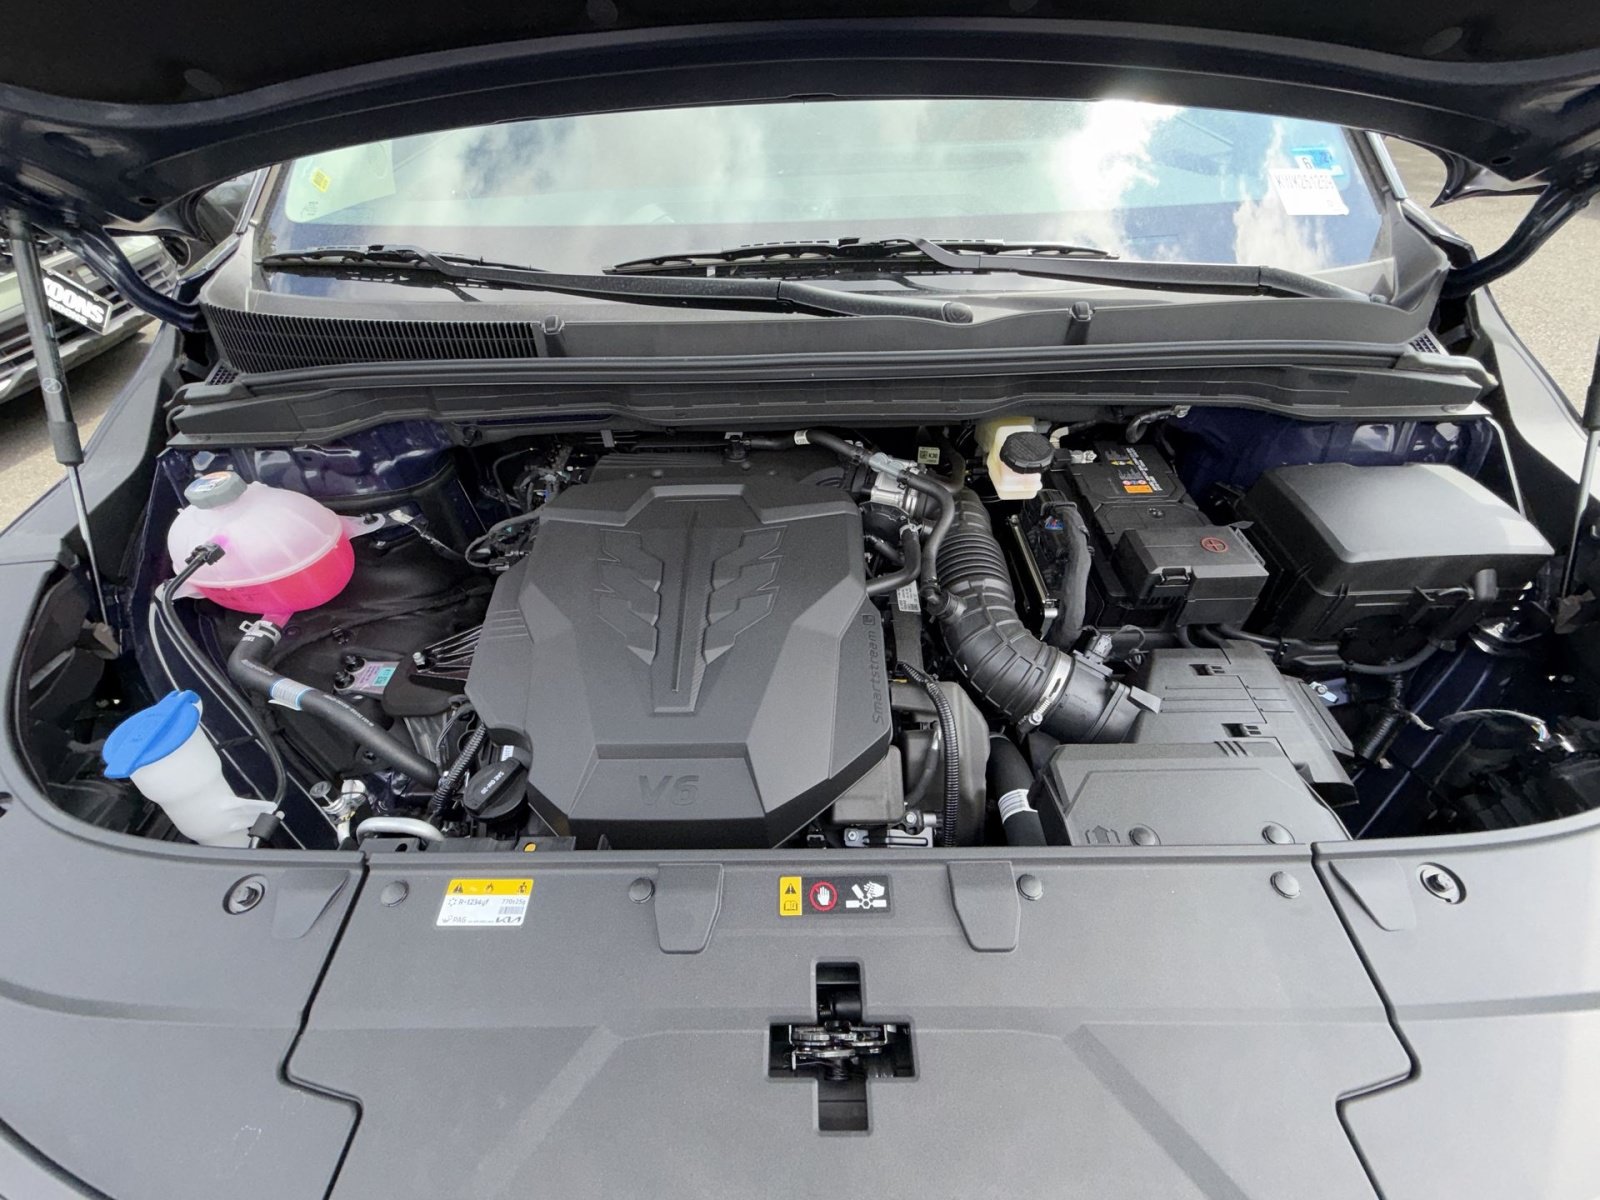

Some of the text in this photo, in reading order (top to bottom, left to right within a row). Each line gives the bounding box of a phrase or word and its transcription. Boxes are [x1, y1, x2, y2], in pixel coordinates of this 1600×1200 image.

[868, 629, 886, 726] Smartstream
[638, 774, 700, 806] V6
[457, 898, 490, 907] R-1234yf
